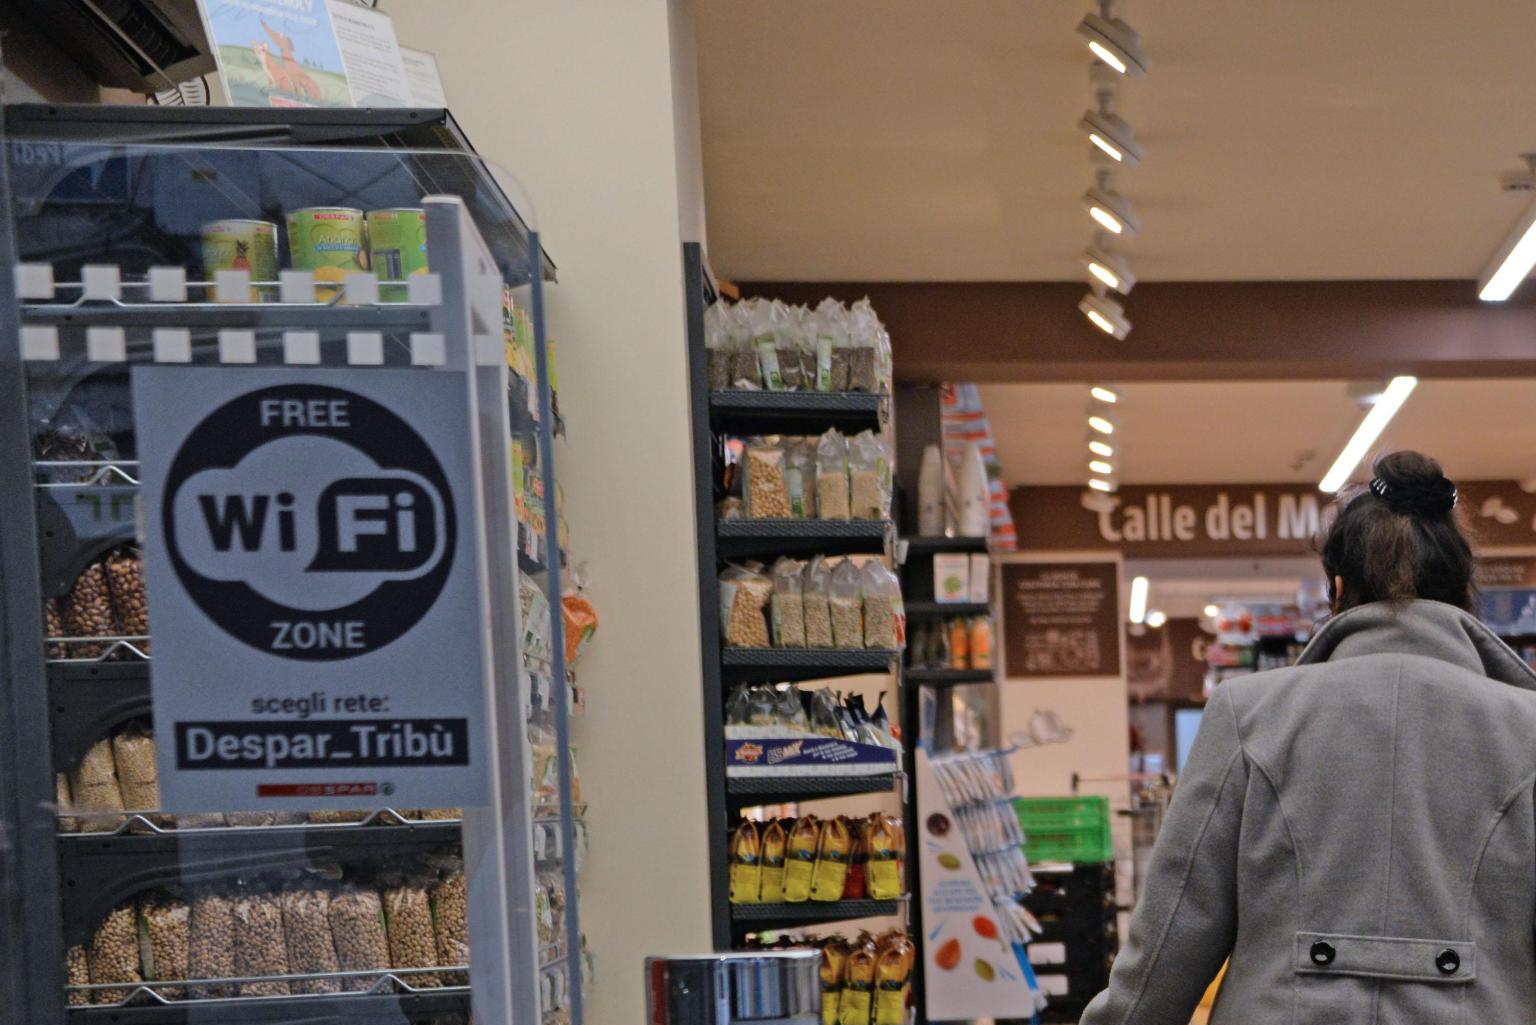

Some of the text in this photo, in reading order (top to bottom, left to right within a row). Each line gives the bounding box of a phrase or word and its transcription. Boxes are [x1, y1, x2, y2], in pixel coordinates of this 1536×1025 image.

[260, 400, 350, 427] FREE
[1098, 492, 1198, 543] Calle
[1205, 492, 1268, 542] del
[270, 621, 367, 649] ZONE
[252, 691, 390, 719] scegli rete:
[185, 722, 454, 768] Despar_Tribù
